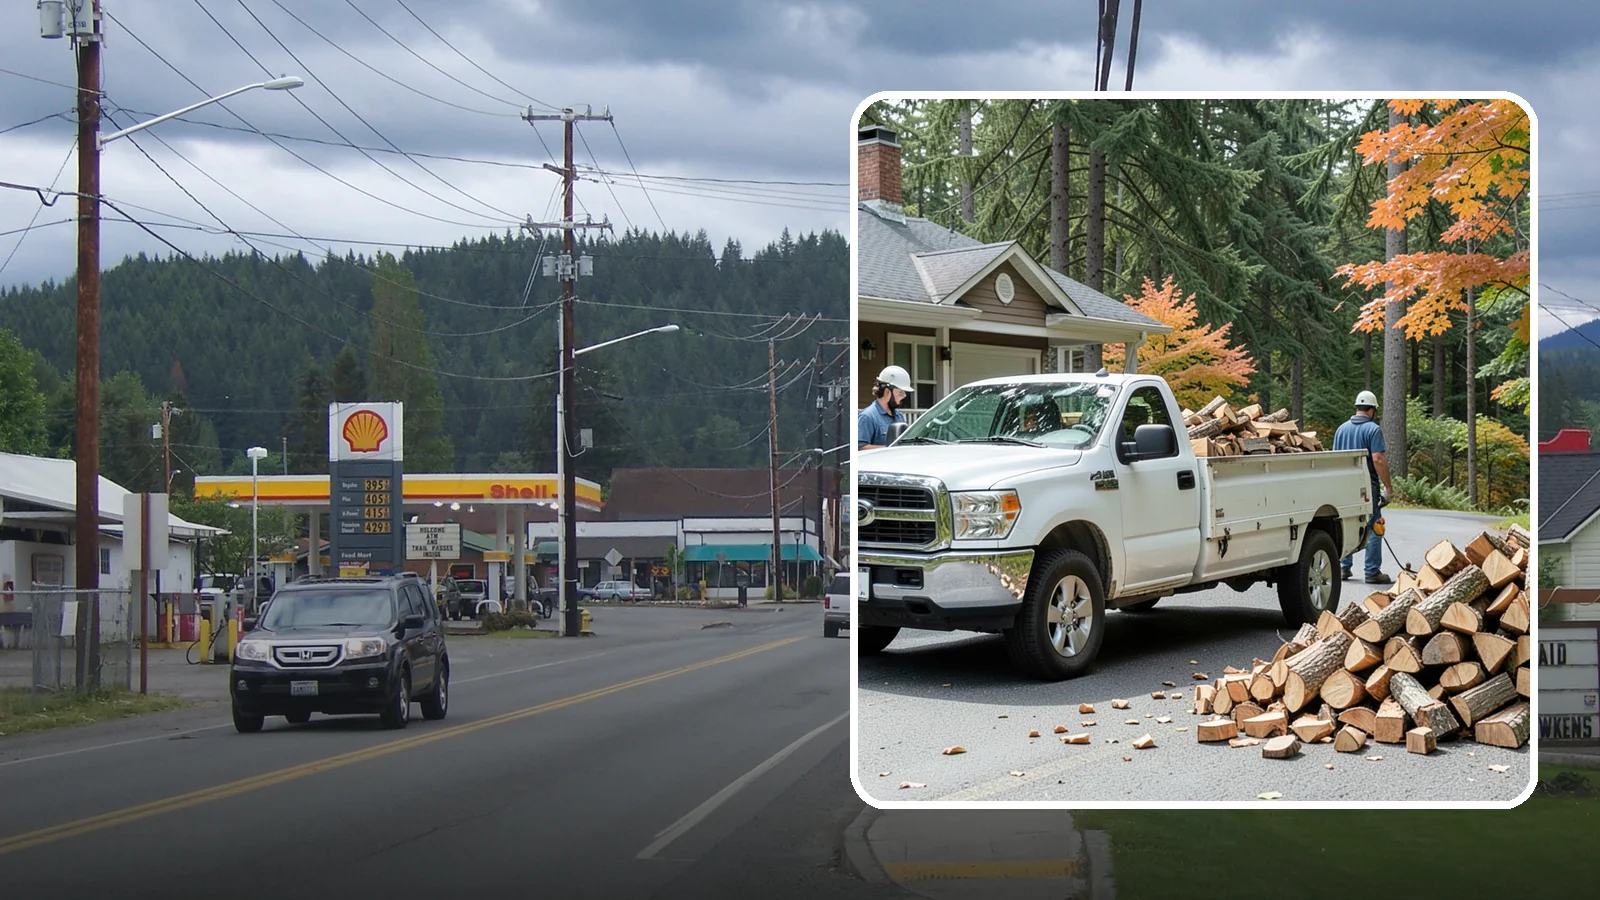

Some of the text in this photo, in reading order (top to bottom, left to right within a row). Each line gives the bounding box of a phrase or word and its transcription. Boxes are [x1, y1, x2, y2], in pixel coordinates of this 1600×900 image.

[366, 480, 383, 490] 395
[490, 484, 547, 499] Shell
[366, 494, 383, 504] 405
[366, 508, 383, 518] 415
[366, 522, 383, 533] 429
